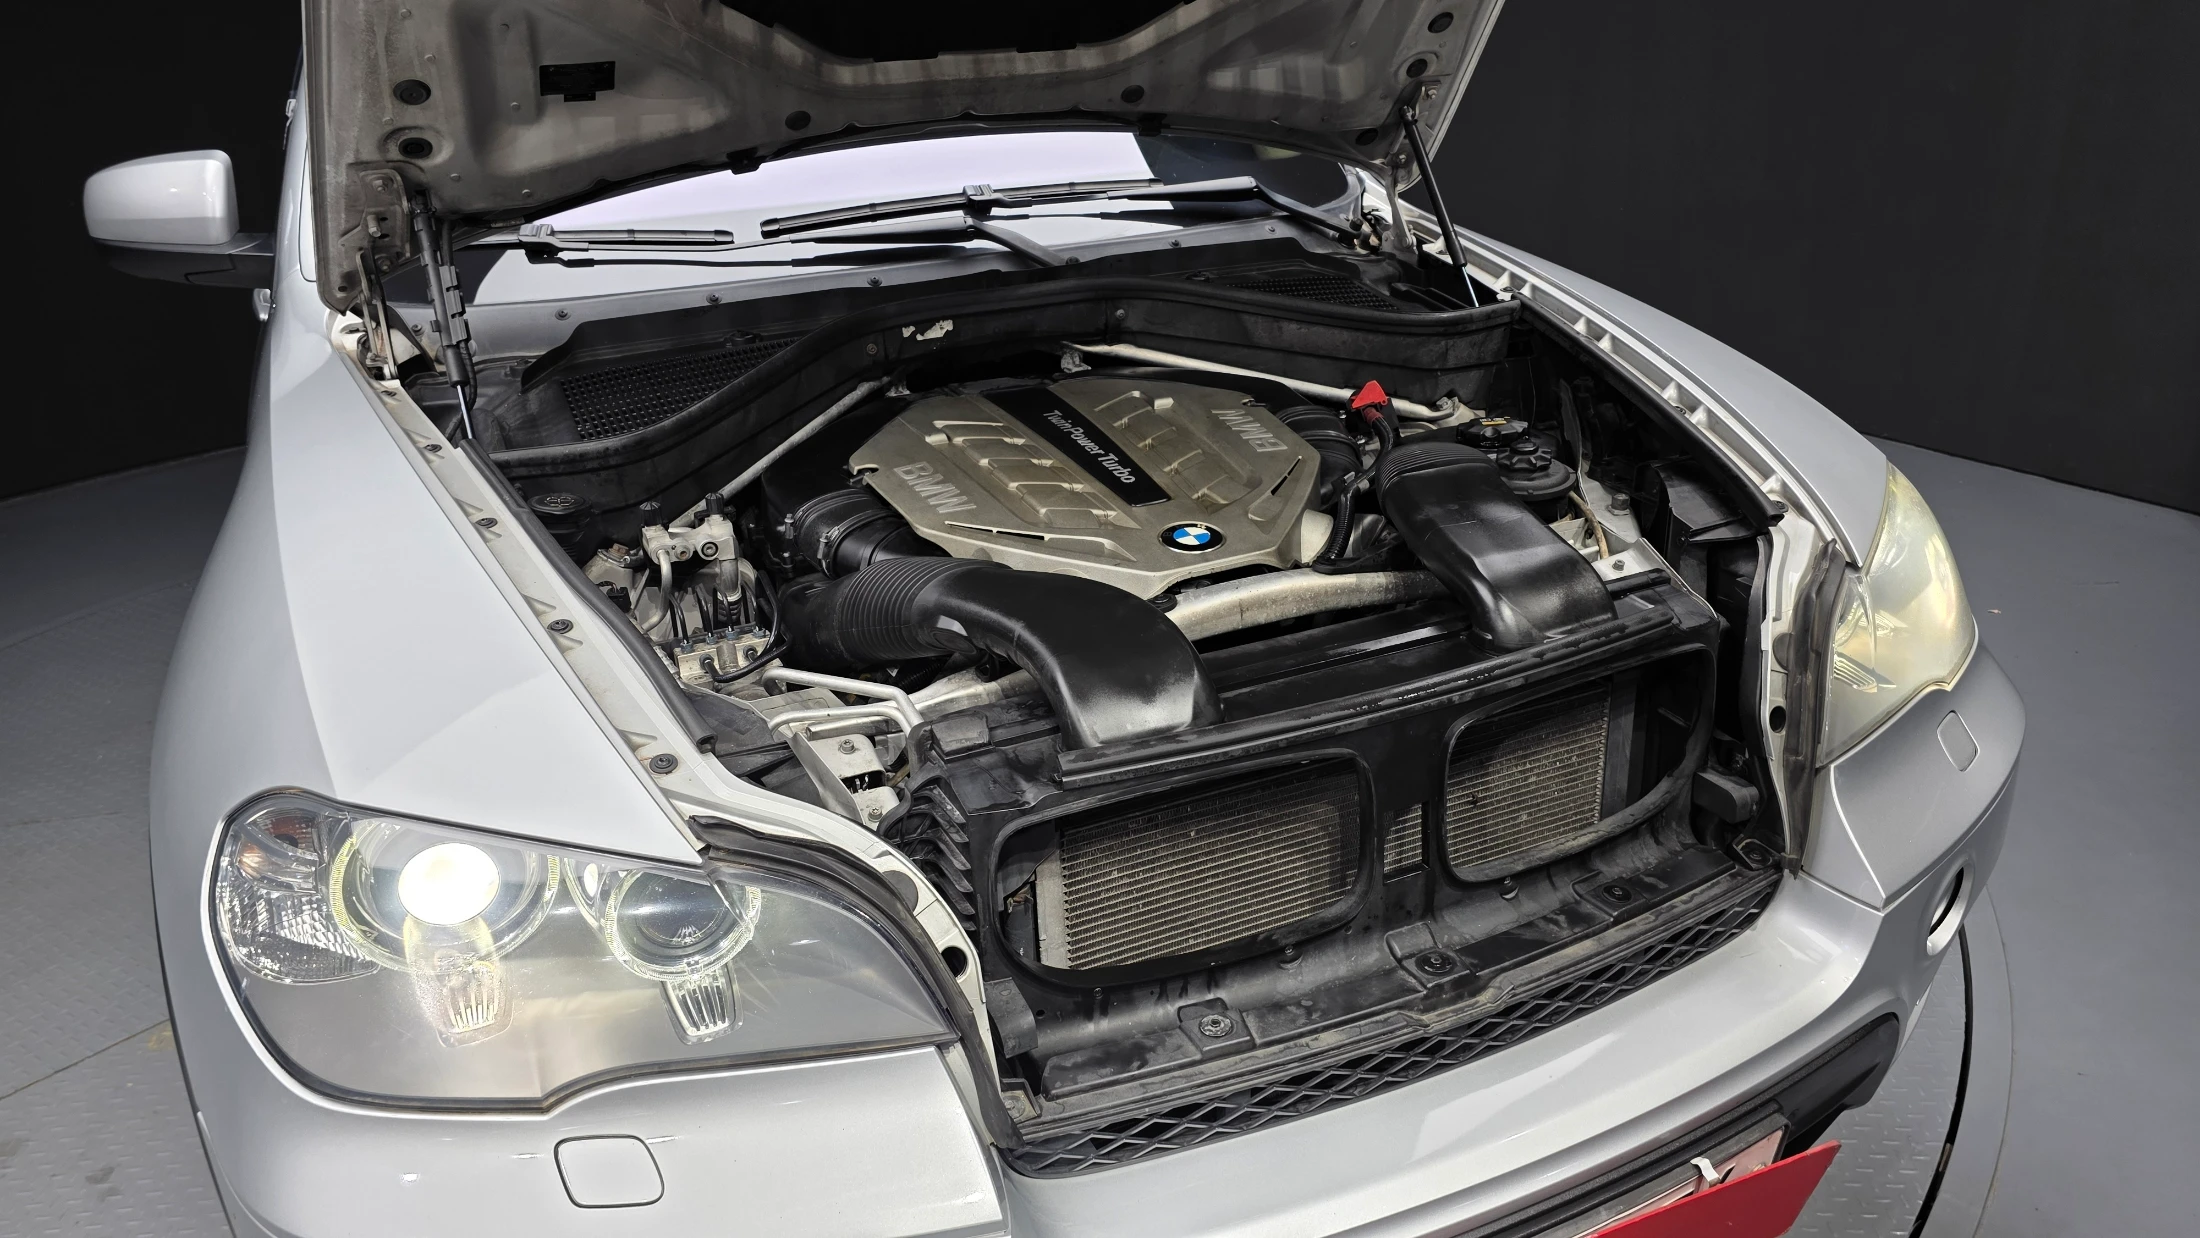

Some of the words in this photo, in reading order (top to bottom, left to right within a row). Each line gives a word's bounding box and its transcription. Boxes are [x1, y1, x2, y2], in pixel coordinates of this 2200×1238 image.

[1043, 410, 1105, 455] TwinPower
[1098, 453, 1136, 483] Turbo
[1210, 408, 1288, 452] BMW
[893, 461, 977, 513] BMW
